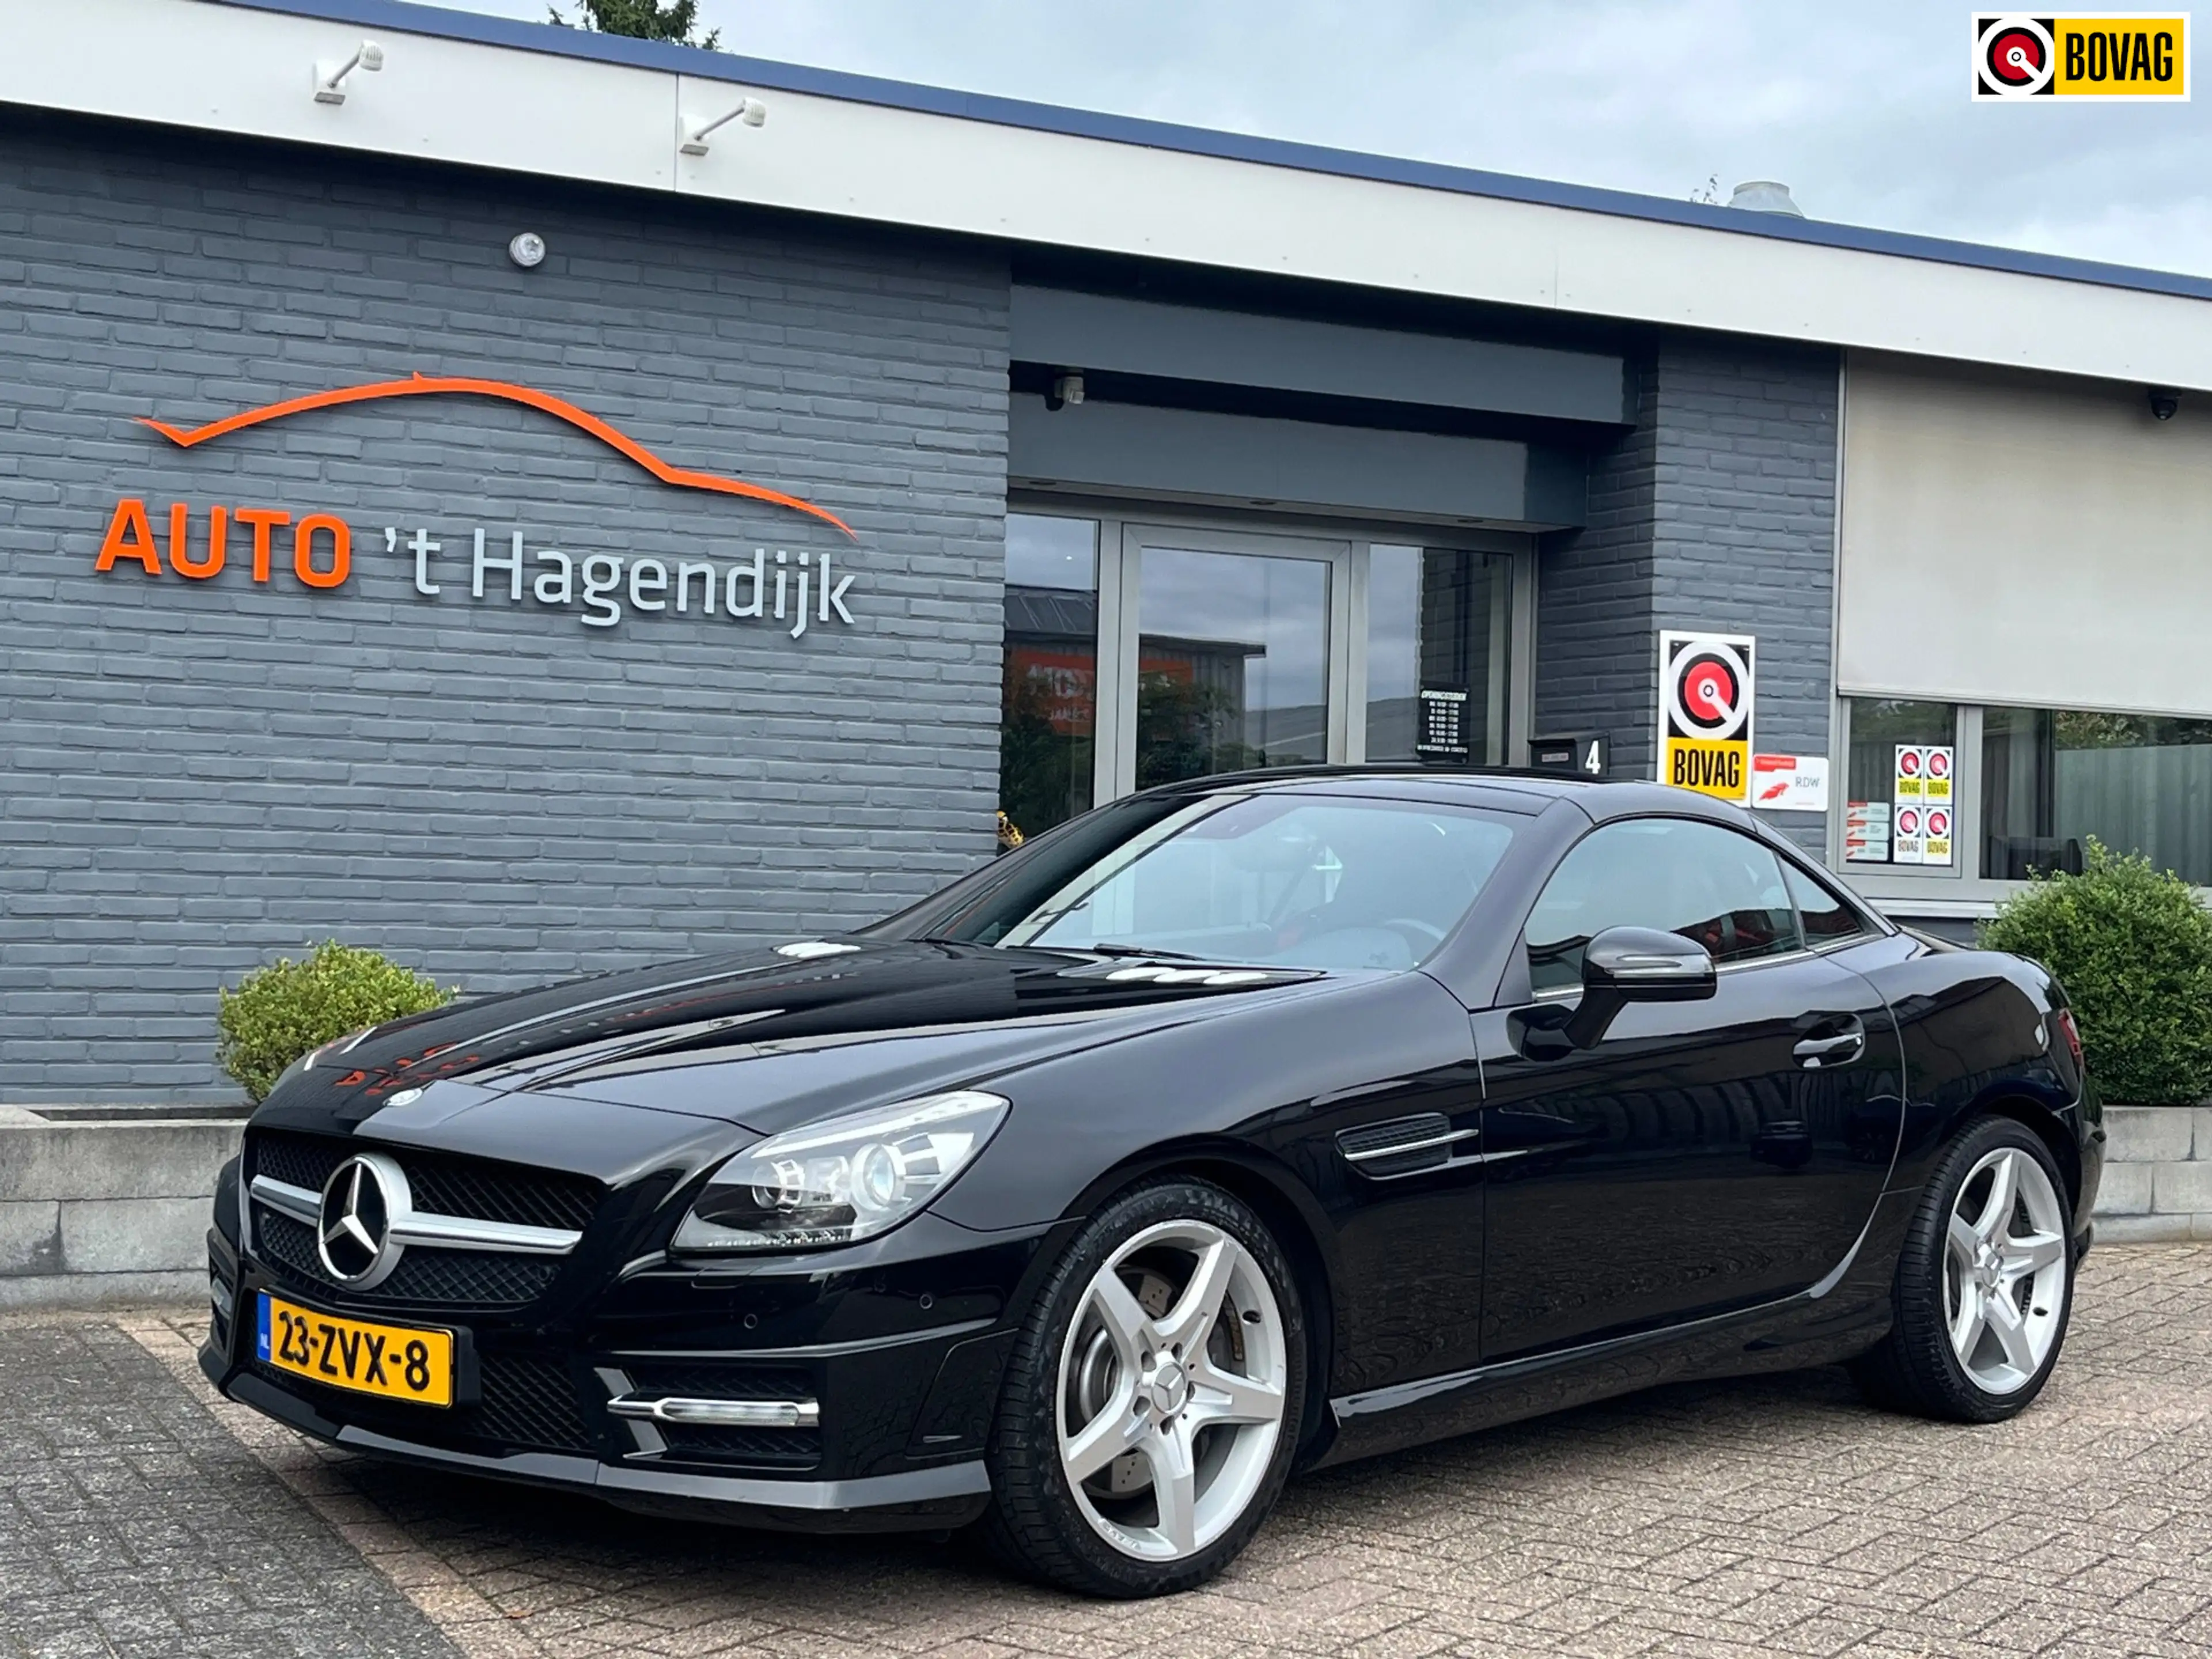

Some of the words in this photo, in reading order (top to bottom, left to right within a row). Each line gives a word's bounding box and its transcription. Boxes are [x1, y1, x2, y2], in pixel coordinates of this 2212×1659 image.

[94, 498, 351, 588] AUTO
[384, 527, 441, 595] 't
[472, 528, 856, 639] Hagendijk
[1585, 740, 1601, 774] 4
[1673, 748, 1740, 788] BOVAG
[1795, 775, 1820, 788] RDW
[278, 1310, 430, 1392] 23-ZVX-8
